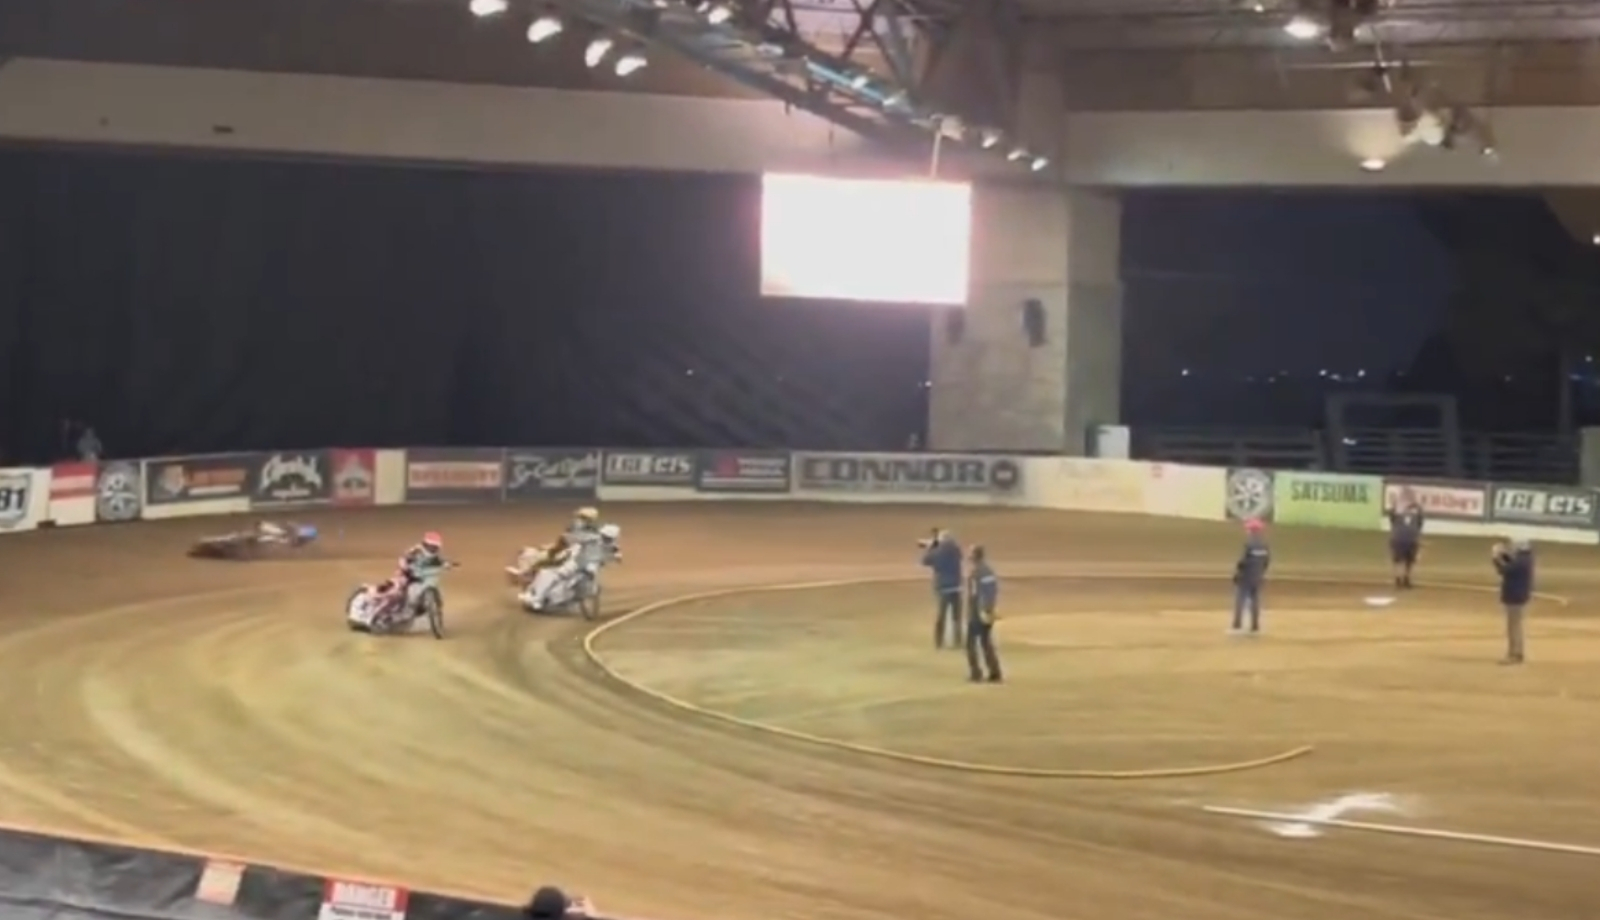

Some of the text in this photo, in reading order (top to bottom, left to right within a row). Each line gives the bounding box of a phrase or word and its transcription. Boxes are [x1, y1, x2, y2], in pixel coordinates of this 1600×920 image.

[803, 457, 985, 484] CONNOR
[1291, 479, 1369, 505] SATSUMA
[1549, 494, 1592, 515] CTS
